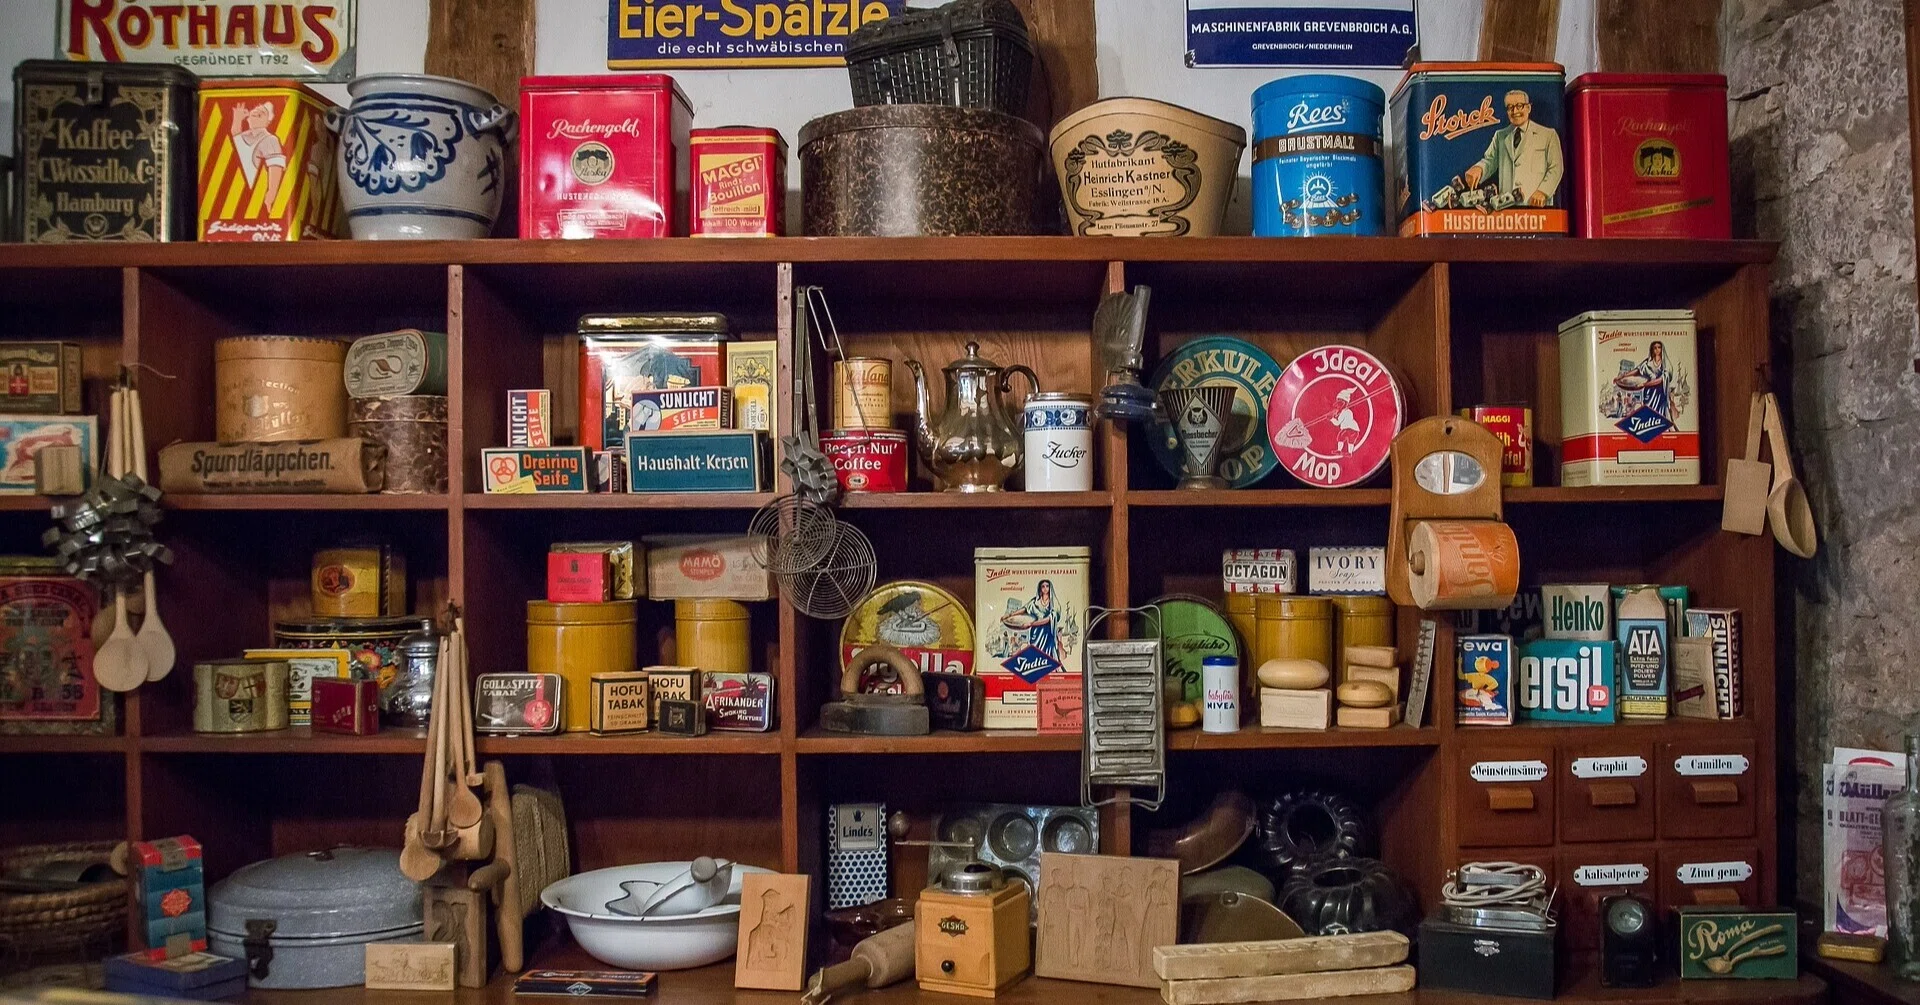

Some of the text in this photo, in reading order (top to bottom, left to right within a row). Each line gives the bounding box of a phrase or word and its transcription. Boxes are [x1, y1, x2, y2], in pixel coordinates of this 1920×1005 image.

[1191, 21, 1301, 34] MASCHINENFABRIK
[1303, 21, 1388, 34] GREVENBROICH
[657, 40, 844, 54] die echt schwäbischen
[174, 54, 289, 66] GEGRÜNDET 1792
[1286, 101, 1346, 134] Rees
[1420, 94, 1501, 141] Storck
[57, 118, 134, 150] Kaffee
[546, 118, 640, 139] Rachengold
[1278, 135, 1355, 153] BRUSTMALZ
[1084, 170, 1171, 186] Heinrich Kastner
[711, 182, 761, 204] Bouillon
[1091, 186, 1144, 199] Esslingen
[56, 191, 134, 217] Hamburg
[725, 218, 738, 226] 100
[1152, 219, 1159, 227] 27
[1443, 213, 1547, 230] Hustendoktor
[659, 390, 715, 409] SUNLICHT
[672, 407, 705, 426] SEIFE
[722, 391, 730, 427] SUNLICHT
[528, 407, 545, 446] SEIFE
[1482, 415, 1511, 423] MAGGI
[1631, 416, 1665, 437] India
[638, 453, 749, 472] Haushalt-Kerzen
[1041, 440, 1087, 469] Zucker
[1220, 444, 1265, 481] OP
[191, 448, 335, 480] Spundläppchen.
[522, 453, 579, 474] Dreiring
[834, 458, 881, 470] Coffee
[1292, 452, 1342, 484] Mop
[533, 470, 570, 486] Seife
[683, 555, 721, 568] MAMÖ
[1317, 555, 1378, 570] IVORY
[1224, 564, 1288, 579] OCTAGON
[1552, 595, 1604, 631] Henko
[1462, 641, 1503, 652] ewa
[1628, 629, 1661, 655] ATA
[1014, 656, 1052, 676] India
[1711, 617, 1730, 715] SUNLICHT
[651, 678, 684, 688] HOFU
[1520, 646, 1602, 712] ersil
[610, 686, 643, 697] HOFU
[650, 691, 686, 700] TABAK
[1592, 690, 1606, 702] D
[608, 699, 645, 710] TABAK
[705, 692, 764, 712] AFRIKANDER
[1207, 702, 1235, 710] NIVEA
[1475, 765, 1543, 777] Weinsteinsäure
[1592, 760, 1629, 773] Graphit
[1690, 758, 1733, 770] Camillen
[843, 825, 873, 838] Linde's
[1690, 867, 1741, 882] Zimt gem.
[1688, 919, 1756, 960] Roma
